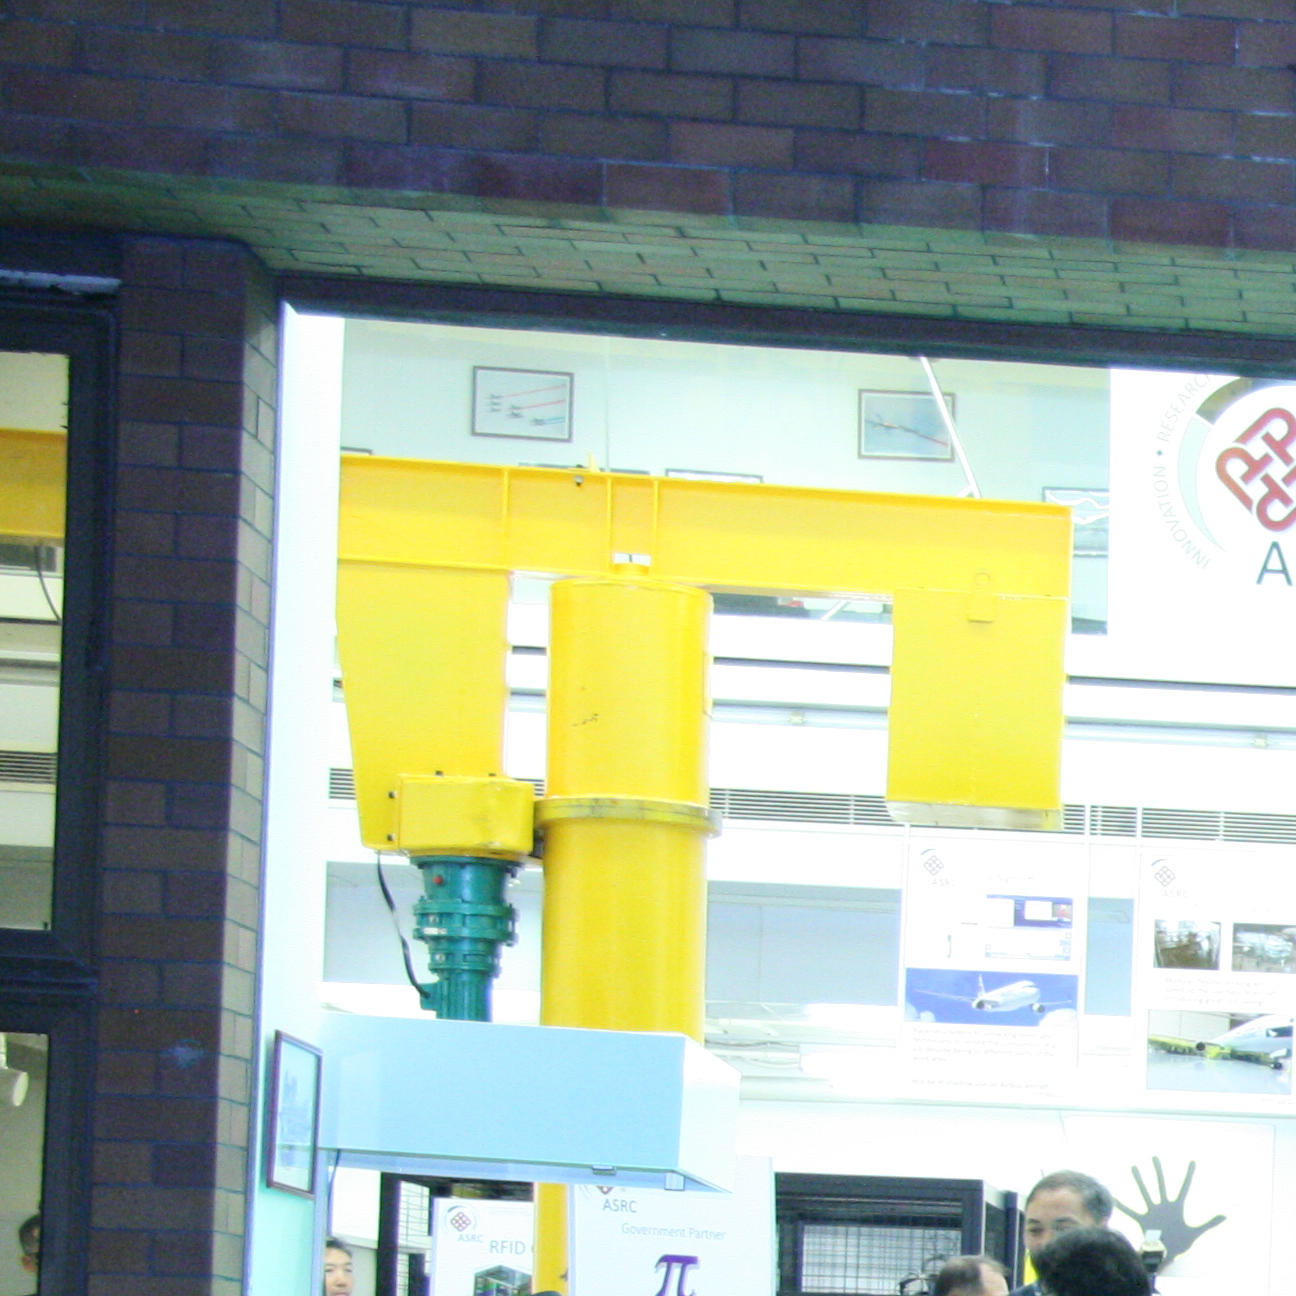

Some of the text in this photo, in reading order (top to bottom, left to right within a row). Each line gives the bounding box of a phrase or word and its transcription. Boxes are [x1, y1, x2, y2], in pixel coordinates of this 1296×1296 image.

[1153, 465, 1212, 571] INNOVATION
[602, 1198, 638, 1214] ASRC
[456, 1233, 485, 1243] ASRC
[621, 1222, 727, 1241] Government Partner
[489, 1239, 527, 1256] RFID
